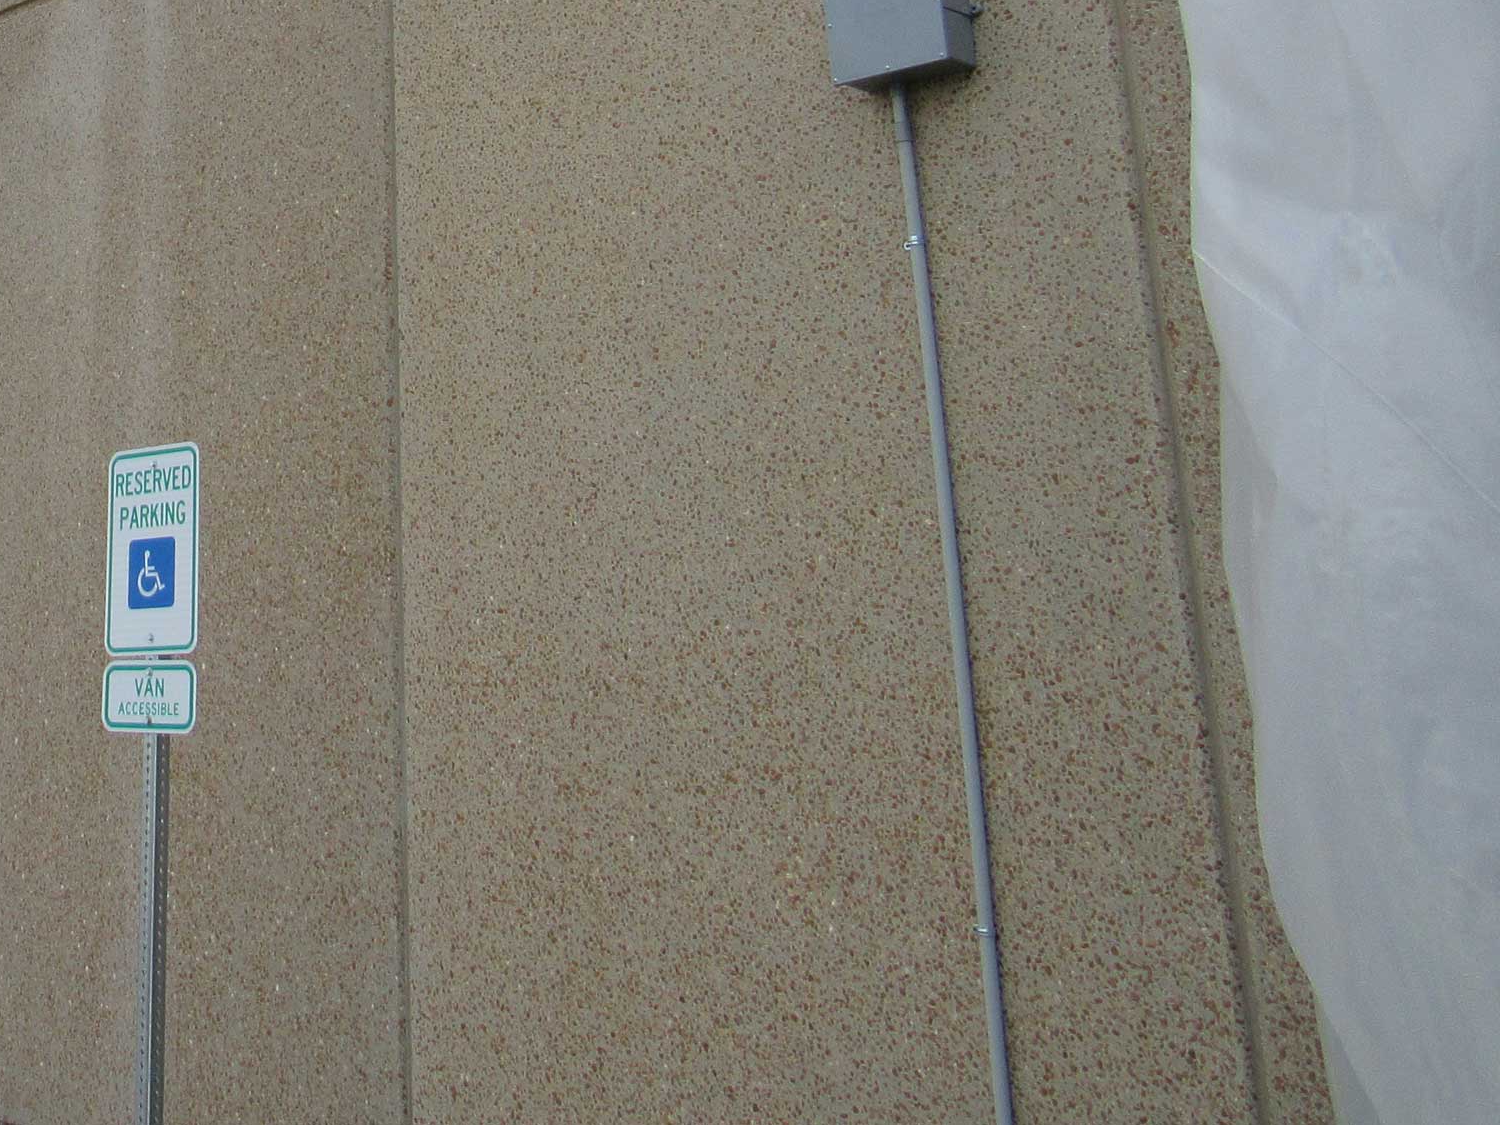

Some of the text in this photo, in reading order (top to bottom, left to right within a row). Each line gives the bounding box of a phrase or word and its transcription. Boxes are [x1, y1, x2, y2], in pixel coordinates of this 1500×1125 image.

[116, 465, 191, 497] RESERVED
[120, 500, 186, 530] PARKING
[135, 678, 165, 697] VAN
[118, 703, 179, 716] ACCESSIBLE
